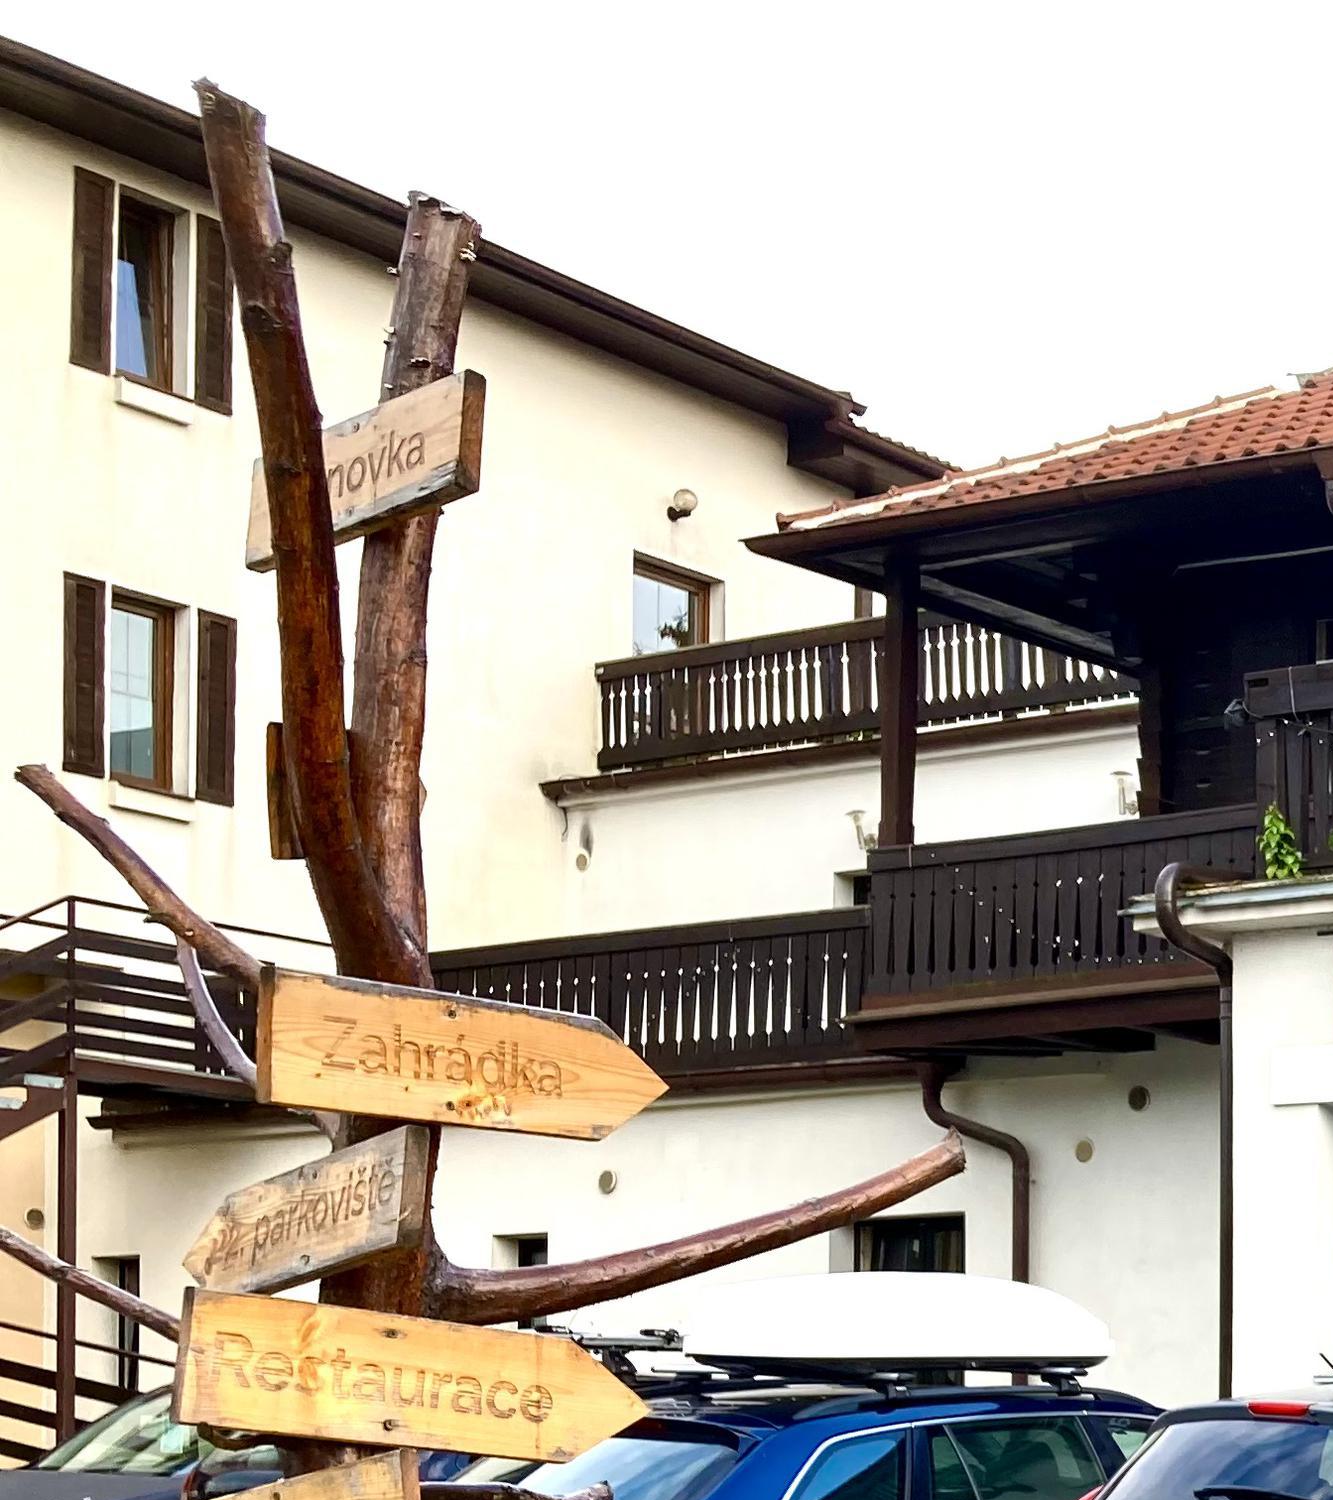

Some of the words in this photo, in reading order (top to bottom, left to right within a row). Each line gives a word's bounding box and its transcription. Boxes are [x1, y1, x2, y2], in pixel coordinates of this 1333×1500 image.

[320, 1014, 564, 1097] Zahrádka
[250, 1156, 397, 1266] parkoviště
[210, 1330, 554, 1424] Restaurace
